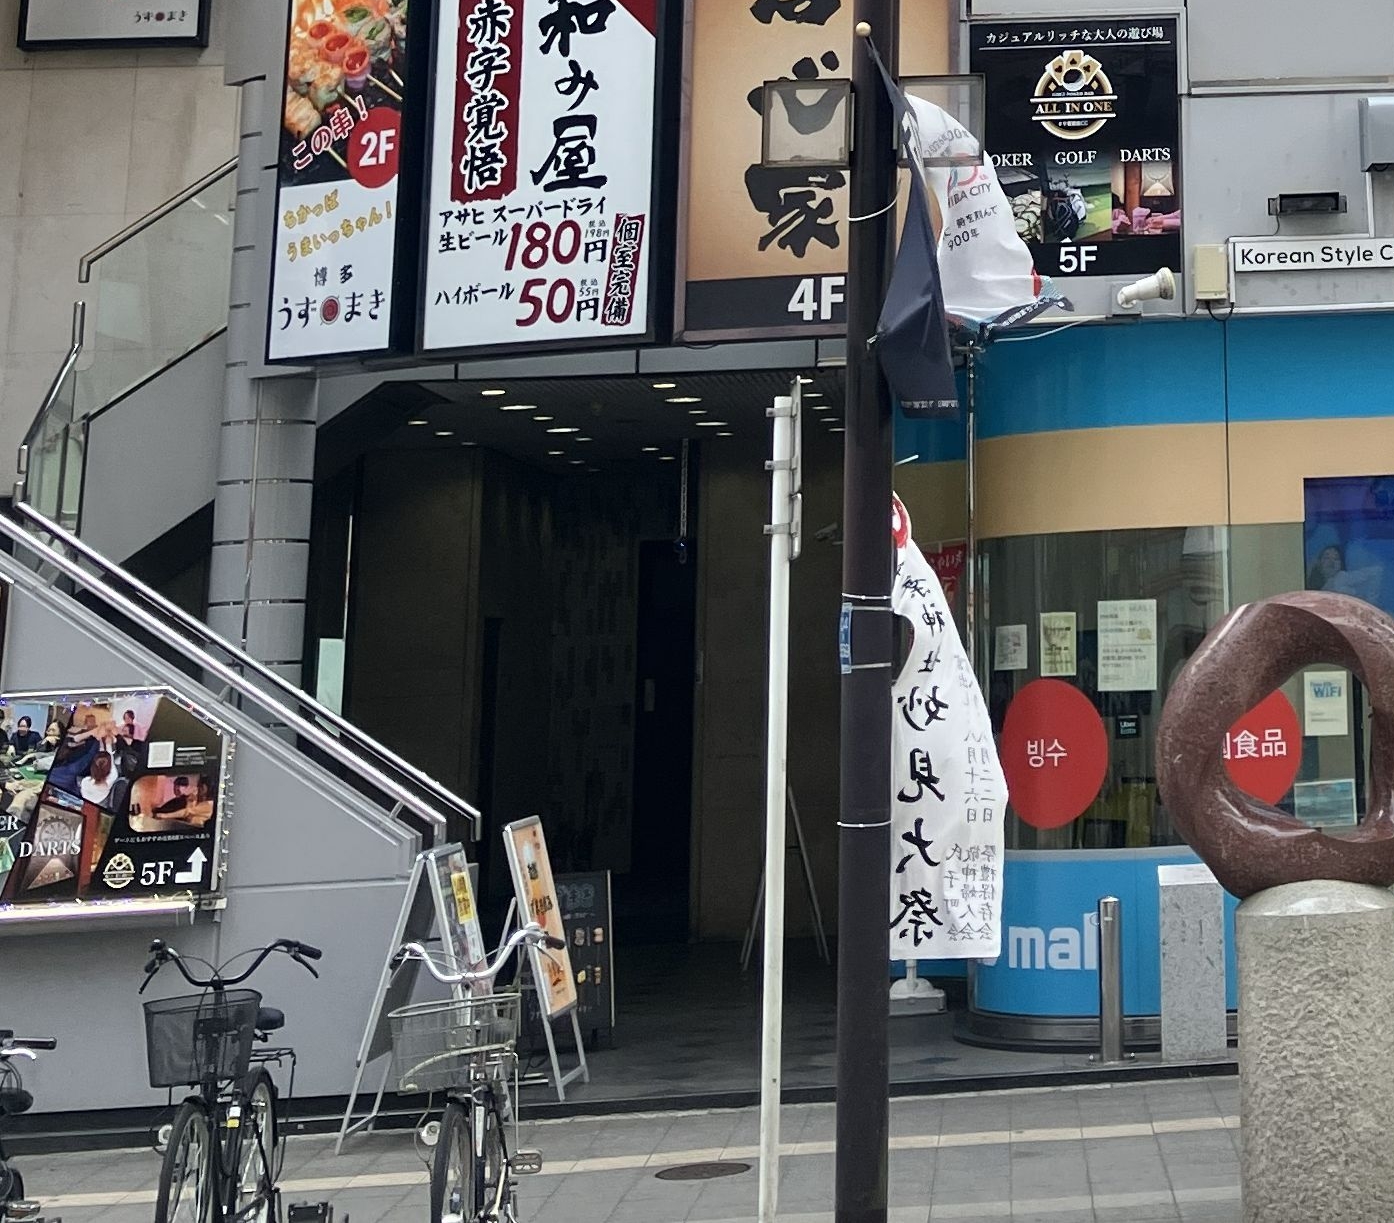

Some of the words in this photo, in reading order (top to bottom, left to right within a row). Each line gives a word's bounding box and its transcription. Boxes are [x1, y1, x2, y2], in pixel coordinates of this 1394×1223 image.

[986, 26, 1164, 45] カジュアルリッチな大人の遊び場
[1035, 103, 1060, 114] ALL
[1065, 102, 1080, 113] IN
[1083, 101, 1113, 112] ONE
[359, 129, 395, 166] 2F
[1055, 151, 1097, 165] GOLF
[1120, 148, 1170, 162] DARTS
[991, 153, 1033, 167] OKER
[969, 182, 992, 197] CITY
[439, 209, 485, 229] アサヒ
[492, 196, 607, 223] スーパードライ
[438, 228, 508, 254] 生ビール
[1059, 245, 1098, 273] 5F
[1240, 247, 1315, 266] Korean
[1320, 245, 1374, 266] Style
[314, 264, 353, 287] 博多
[604, 218, 642, 324] 個室完備
[434, 282, 515, 306] ハイボール
[787, 276, 846, 321] 4F
[1027, 738, 1068, 769] 빙수
[19, 841, 81, 858] DARTS
[140, 861, 173, 885] 5F
[1008, 911, 1099, 970] mal
